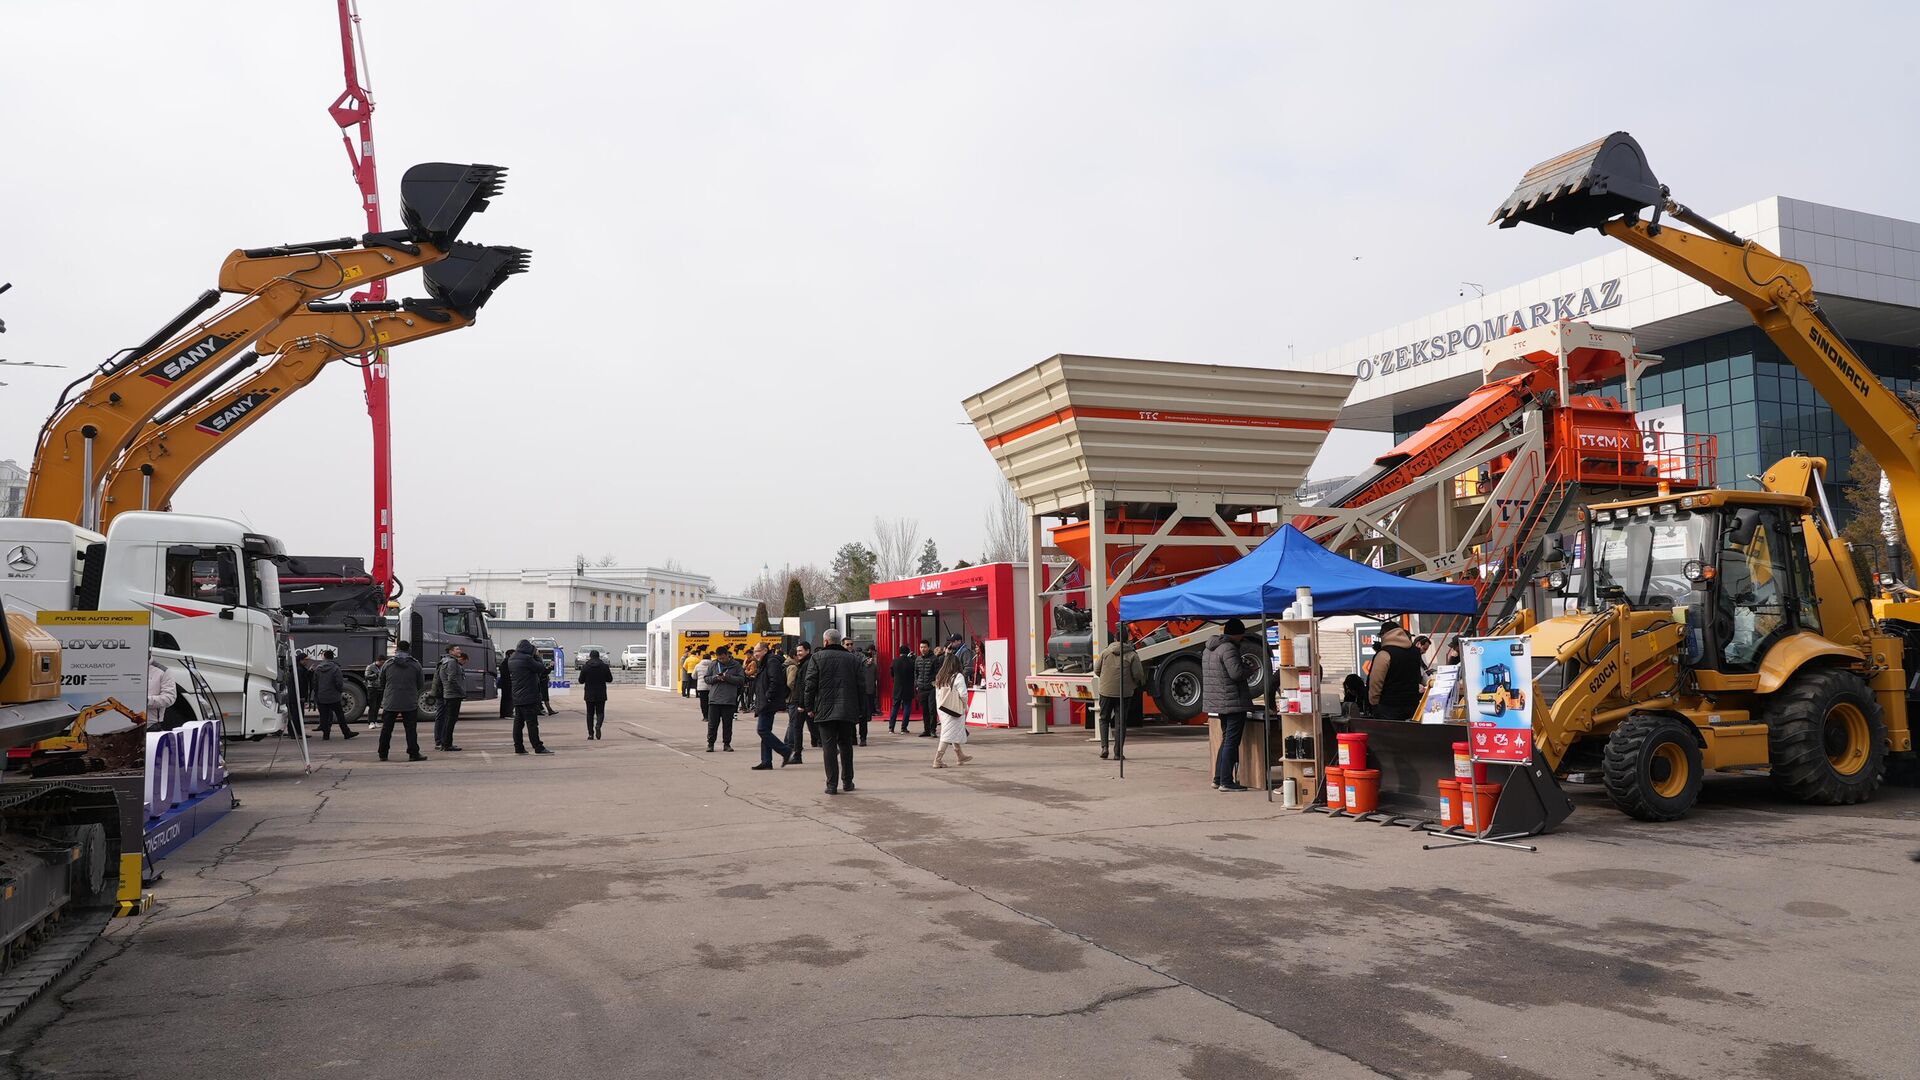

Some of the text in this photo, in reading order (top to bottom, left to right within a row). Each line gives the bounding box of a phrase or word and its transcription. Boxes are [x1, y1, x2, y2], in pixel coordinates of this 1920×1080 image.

[163, 337, 218, 379] SANY
[1808, 326, 1870, 398] SINOMACH
[212, 395, 254, 430] SANY
[1139, 411, 1160, 421] TTC
[1463, 424, 1477, 437] TTC
[1438, 441, 1453, 454] TTC
[1412, 458, 1426, 472] TTC
[1433, 554, 1456, 569] TTC
[926, 579, 942, 591] SANY
[61, 639, 131, 650] LOVOL
[1589, 660, 1618, 694] 620CH
[971, 712, 984, 720] SANY
